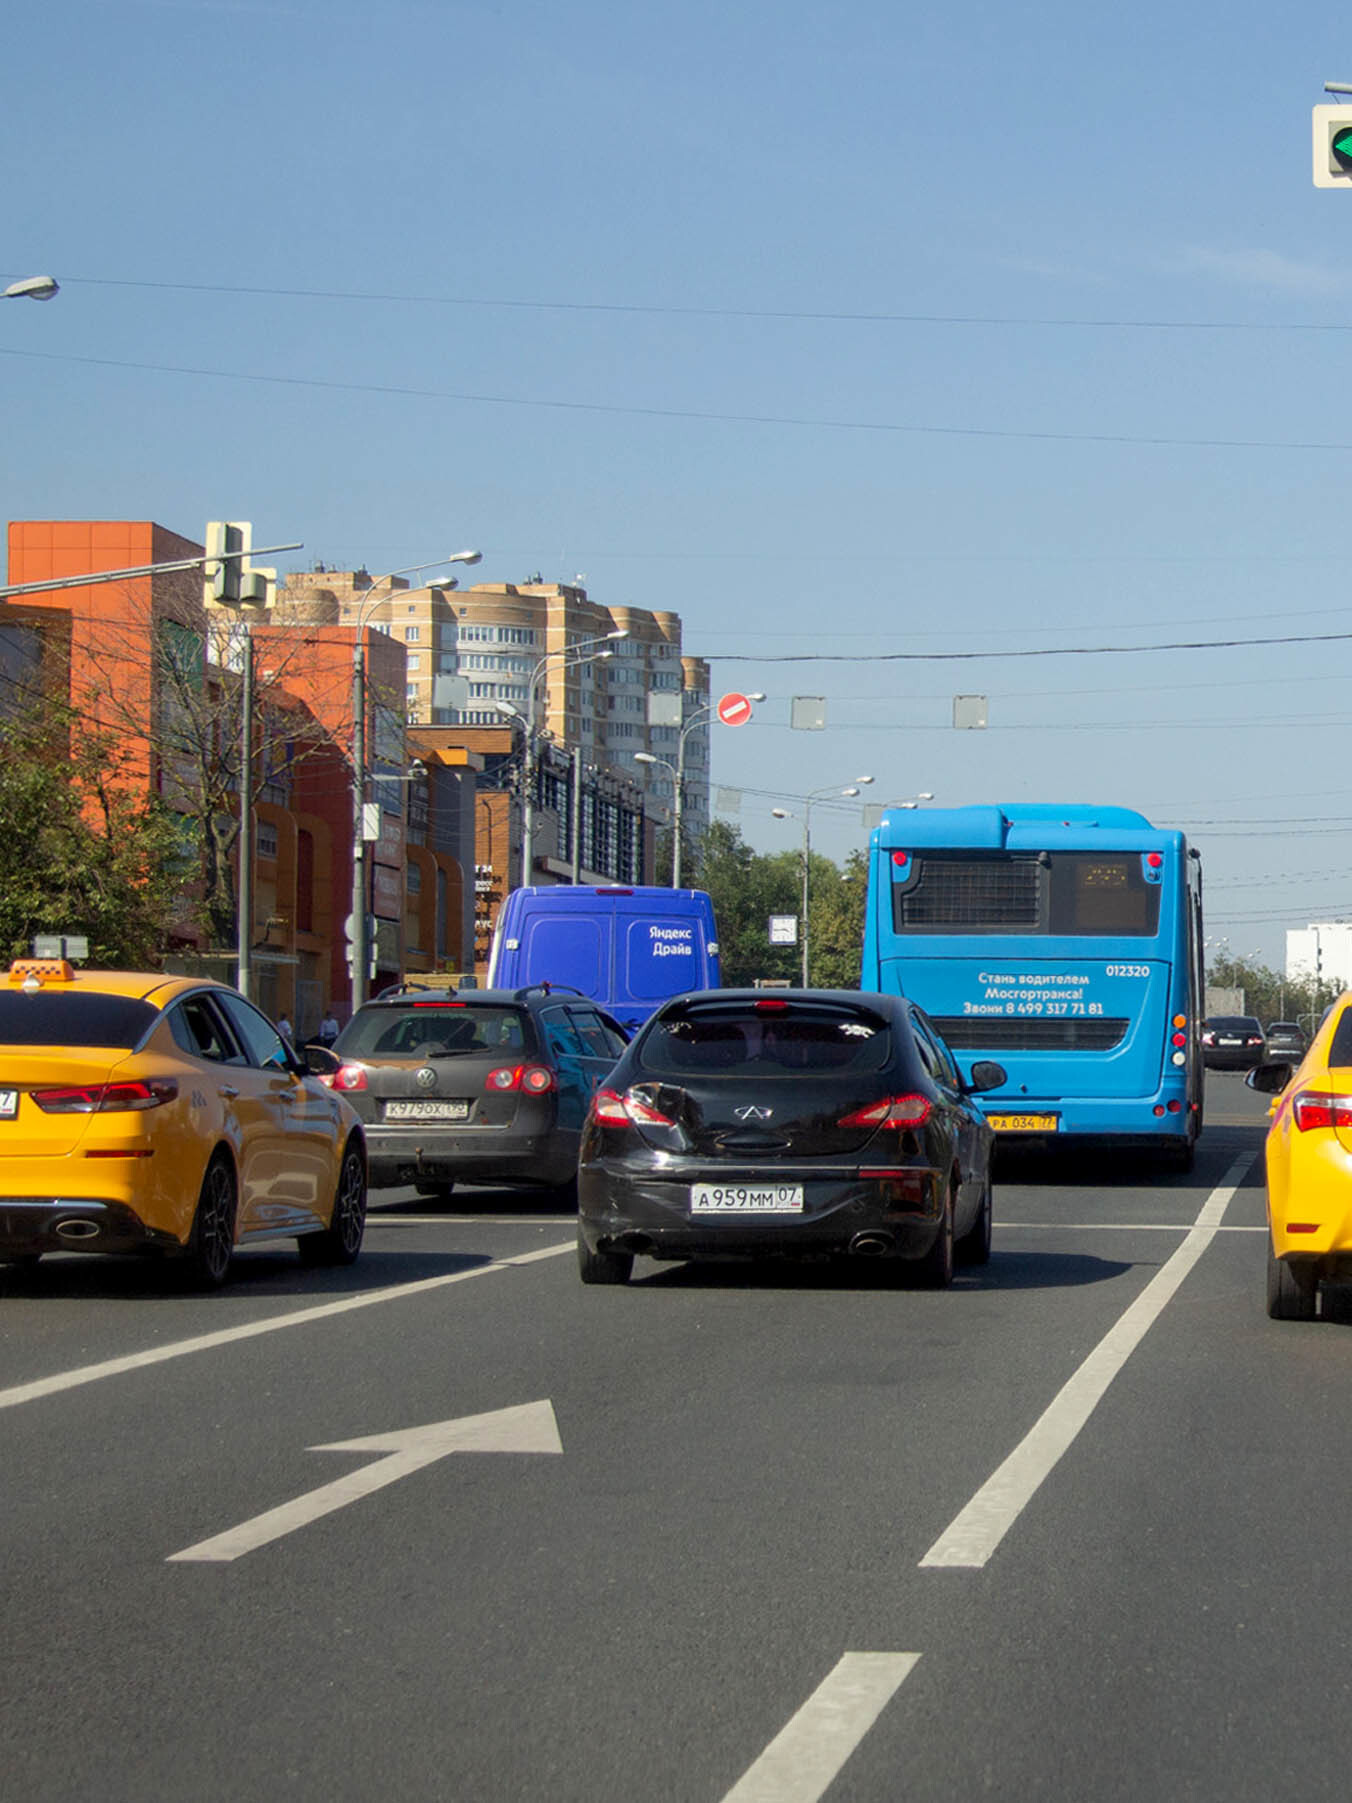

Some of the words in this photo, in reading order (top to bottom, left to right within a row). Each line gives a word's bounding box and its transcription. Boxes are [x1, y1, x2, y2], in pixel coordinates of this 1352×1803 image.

[649, 925, 693, 941] Яндекс
[652, 941, 692, 957] Драйв
[978, 972, 1017, 985] Стань
[1018, 975, 1090, 986] водителем
[1105, 965, 1150, 978] 012320
[984, 987, 1083, 1002] Мосгортранса!
[963, 1001, 1003, 1015] Звони
[1005, 1002, 1015, 1015] 8
[1017, 1002, 1043, 1014] 499
[1046, 1002, 1068, 1015] 317
[1071, 1003, 1085, 1015] 71
[1088, 1003, 1104, 1016] 81
[778, 1187, 796, 1202] 07
